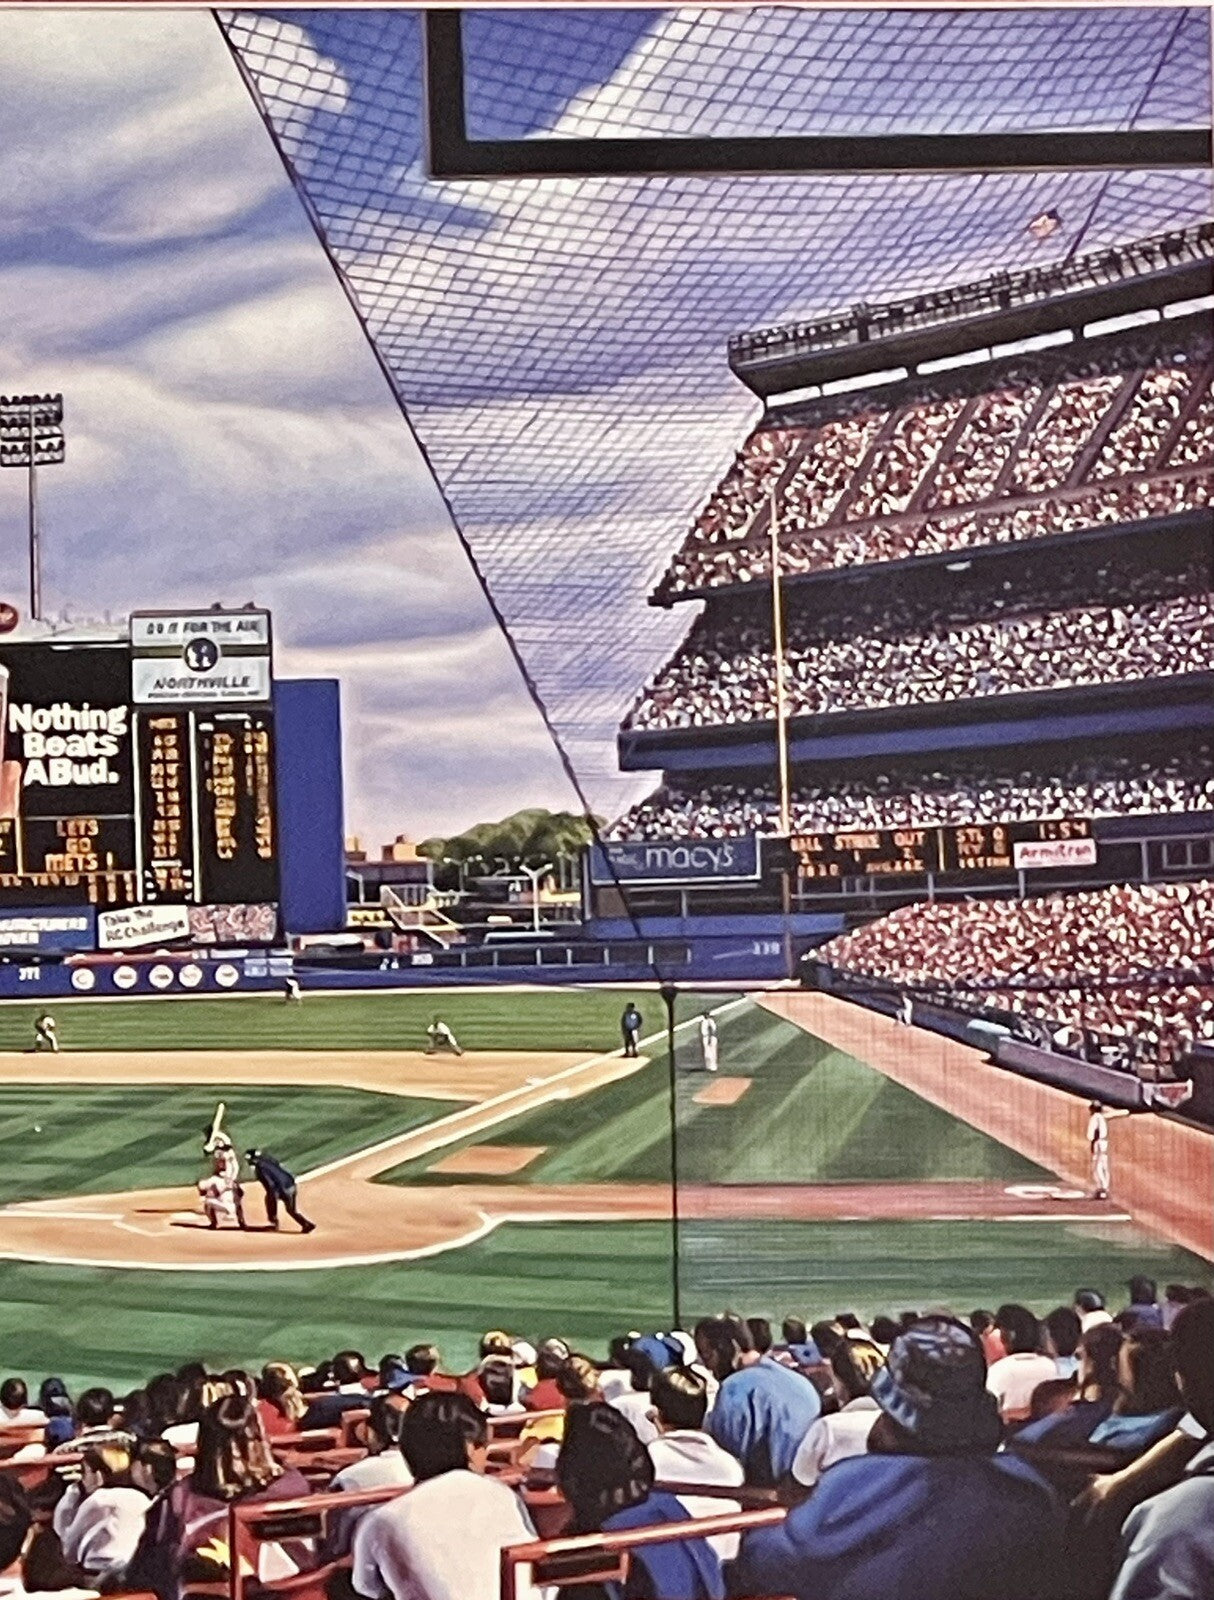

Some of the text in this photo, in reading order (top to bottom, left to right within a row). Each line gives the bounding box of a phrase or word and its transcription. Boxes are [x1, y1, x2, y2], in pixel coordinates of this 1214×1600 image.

[153, 676, 251, 689] NORTHVILLE
[8, 702, 128, 736] Nothing
[23, 757, 120, 786] A Bud.
[56, 819, 99, 837] LETS
[66, 837, 92, 853] GO
[893, 831, 926, 847] OUT
